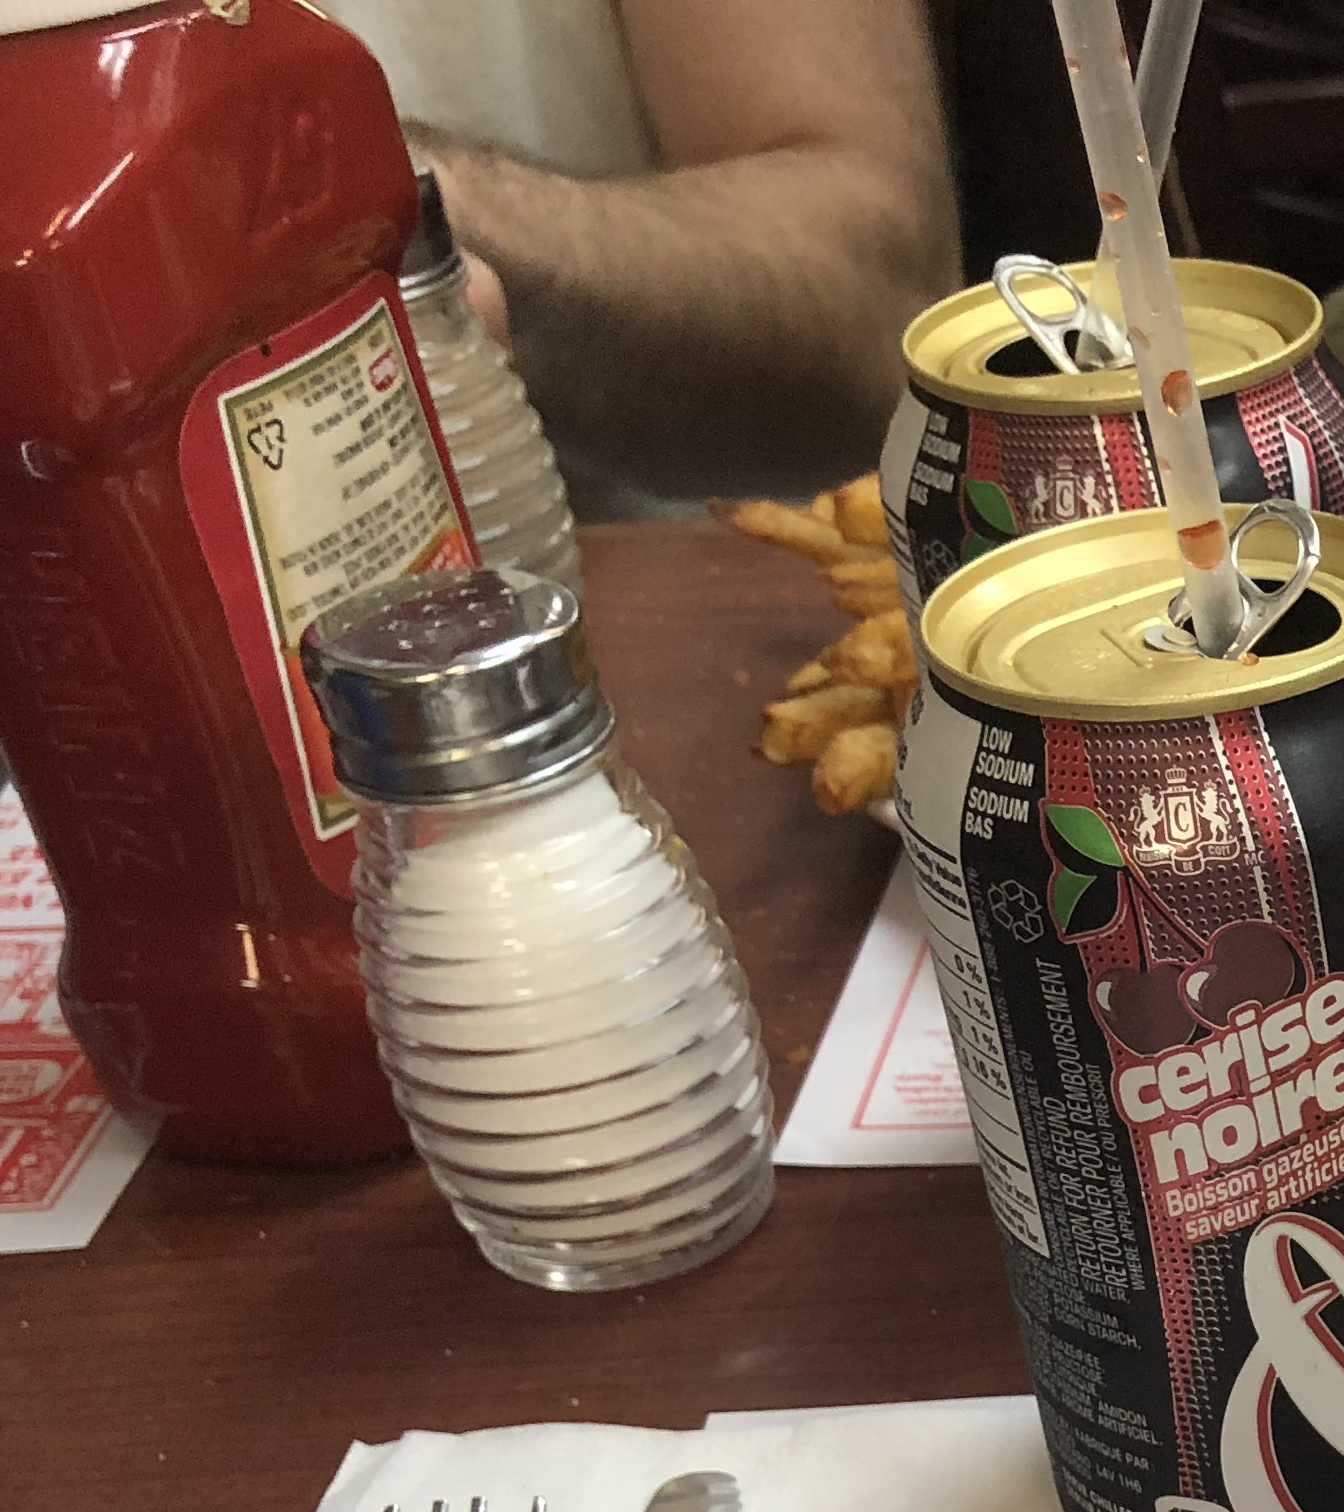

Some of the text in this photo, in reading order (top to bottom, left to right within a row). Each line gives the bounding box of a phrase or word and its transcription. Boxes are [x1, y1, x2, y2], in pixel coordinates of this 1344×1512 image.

[982, 724, 1013, 754] LOW
[976, 752, 1035, 787] SODIUM
[965, 811, 994, 840] BAS
[968, 787, 1031, 823] SODIUM
[1085, 1063, 1113, 1128] PRESCRIT
[1036, 957, 1129, 1288] RETOURNER POUR REMBOURSEMENT
[1043, 1097, 1101, 1281] RETURN FOR REFUND
[1107, 1163, 1136, 1242] APPLICABLE
[1165, 1169, 1257, 1217] Boisson
[1185, 1198, 1261, 1241] saveur
[1124, 1246, 1146, 1291] WHERE
